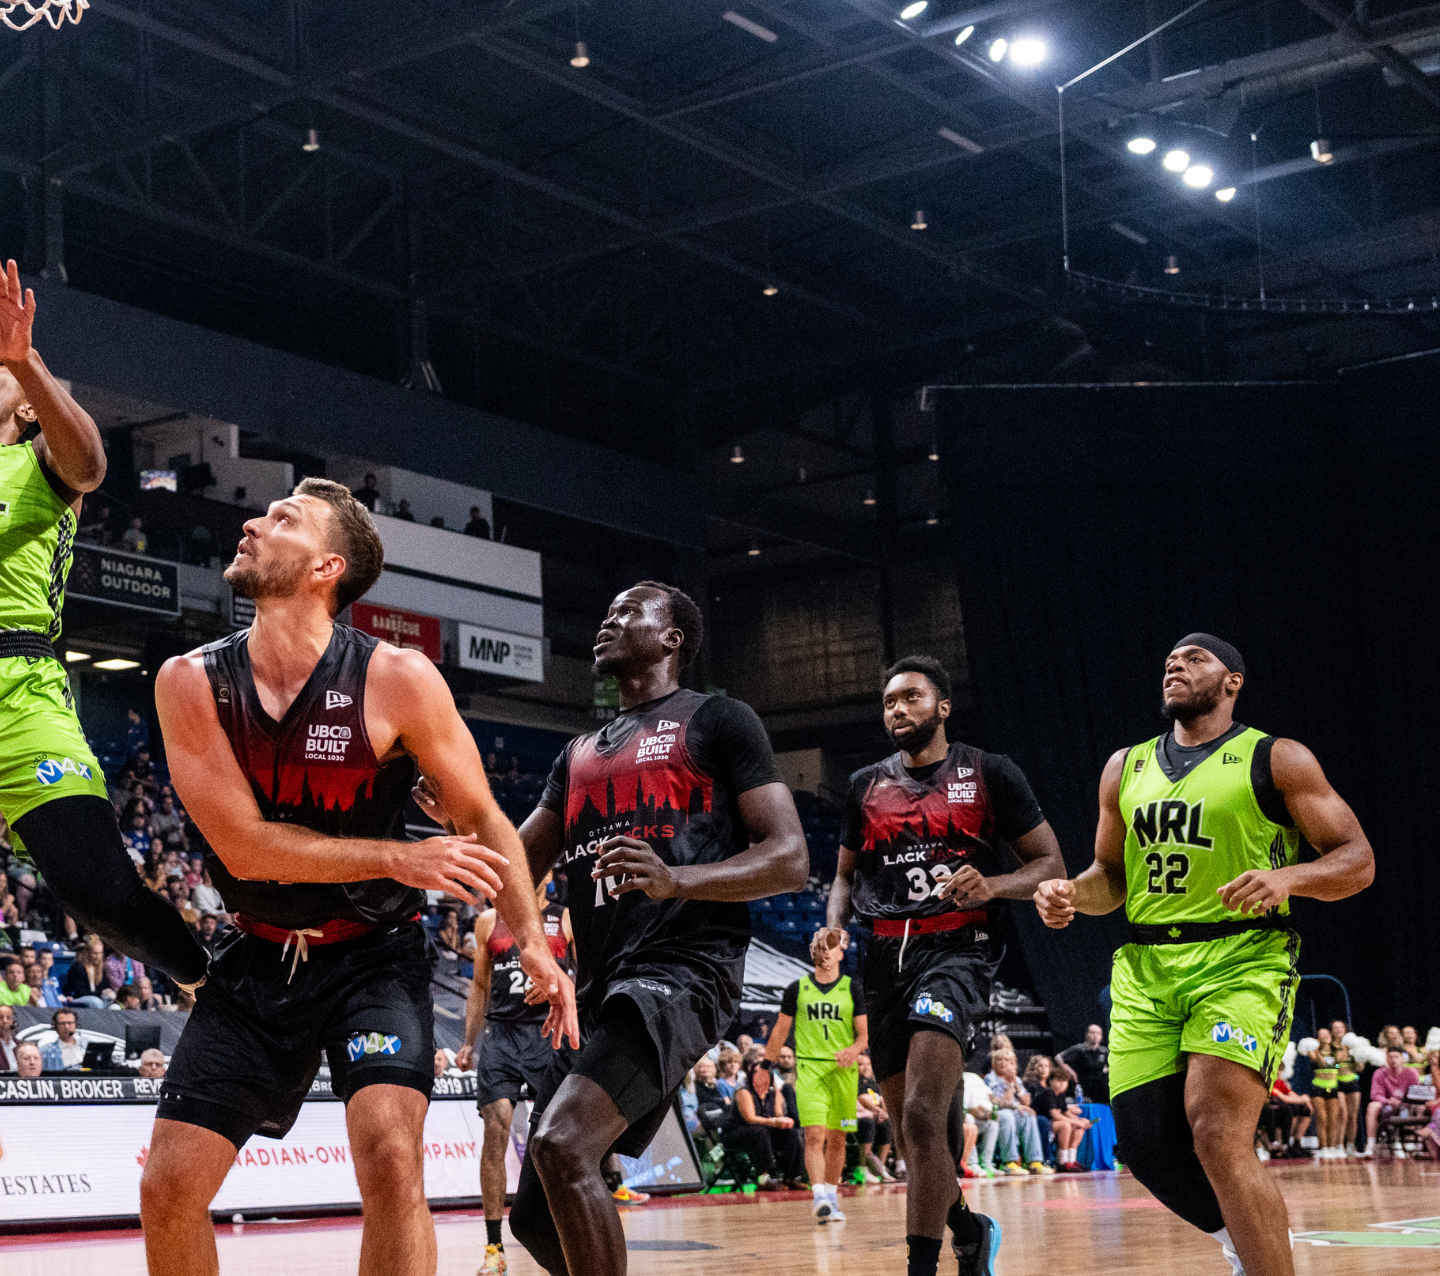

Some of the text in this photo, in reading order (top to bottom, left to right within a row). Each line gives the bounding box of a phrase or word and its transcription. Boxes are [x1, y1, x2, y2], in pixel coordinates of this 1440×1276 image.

[101, 558, 162, 582] NIAGARA
[101, 575, 171, 599] OUTDOOR
[469, 636, 509, 664] MNP
[305, 739, 350, 753] BUILT
[305, 753, 327, 761] LOCAL
[636, 743, 674, 759] BUILT
[37, 757, 92, 785] MAX
[635, 756, 653, 764] LOCAL
[948, 790, 977, 799] BUILT
[588, 820, 631, 838] OTTAWA
[1132, 797, 1215, 852] NRL
[907, 842, 943, 851] OTTAWA
[905, 864, 952, 901] 32
[1144, 851, 1190, 896] 22
[806, 1002, 843, 1021] NRL
[916, 998, 953, 1022] MAX
[822, 1024, 829, 1041] 1
[1212, 1022, 1257, 1051] MAX
[347, 1032, 399, 1061] MAX
[60, 1080, 125, 1099] BROKER
[2, 1173, 92, 1196] ESTATES
